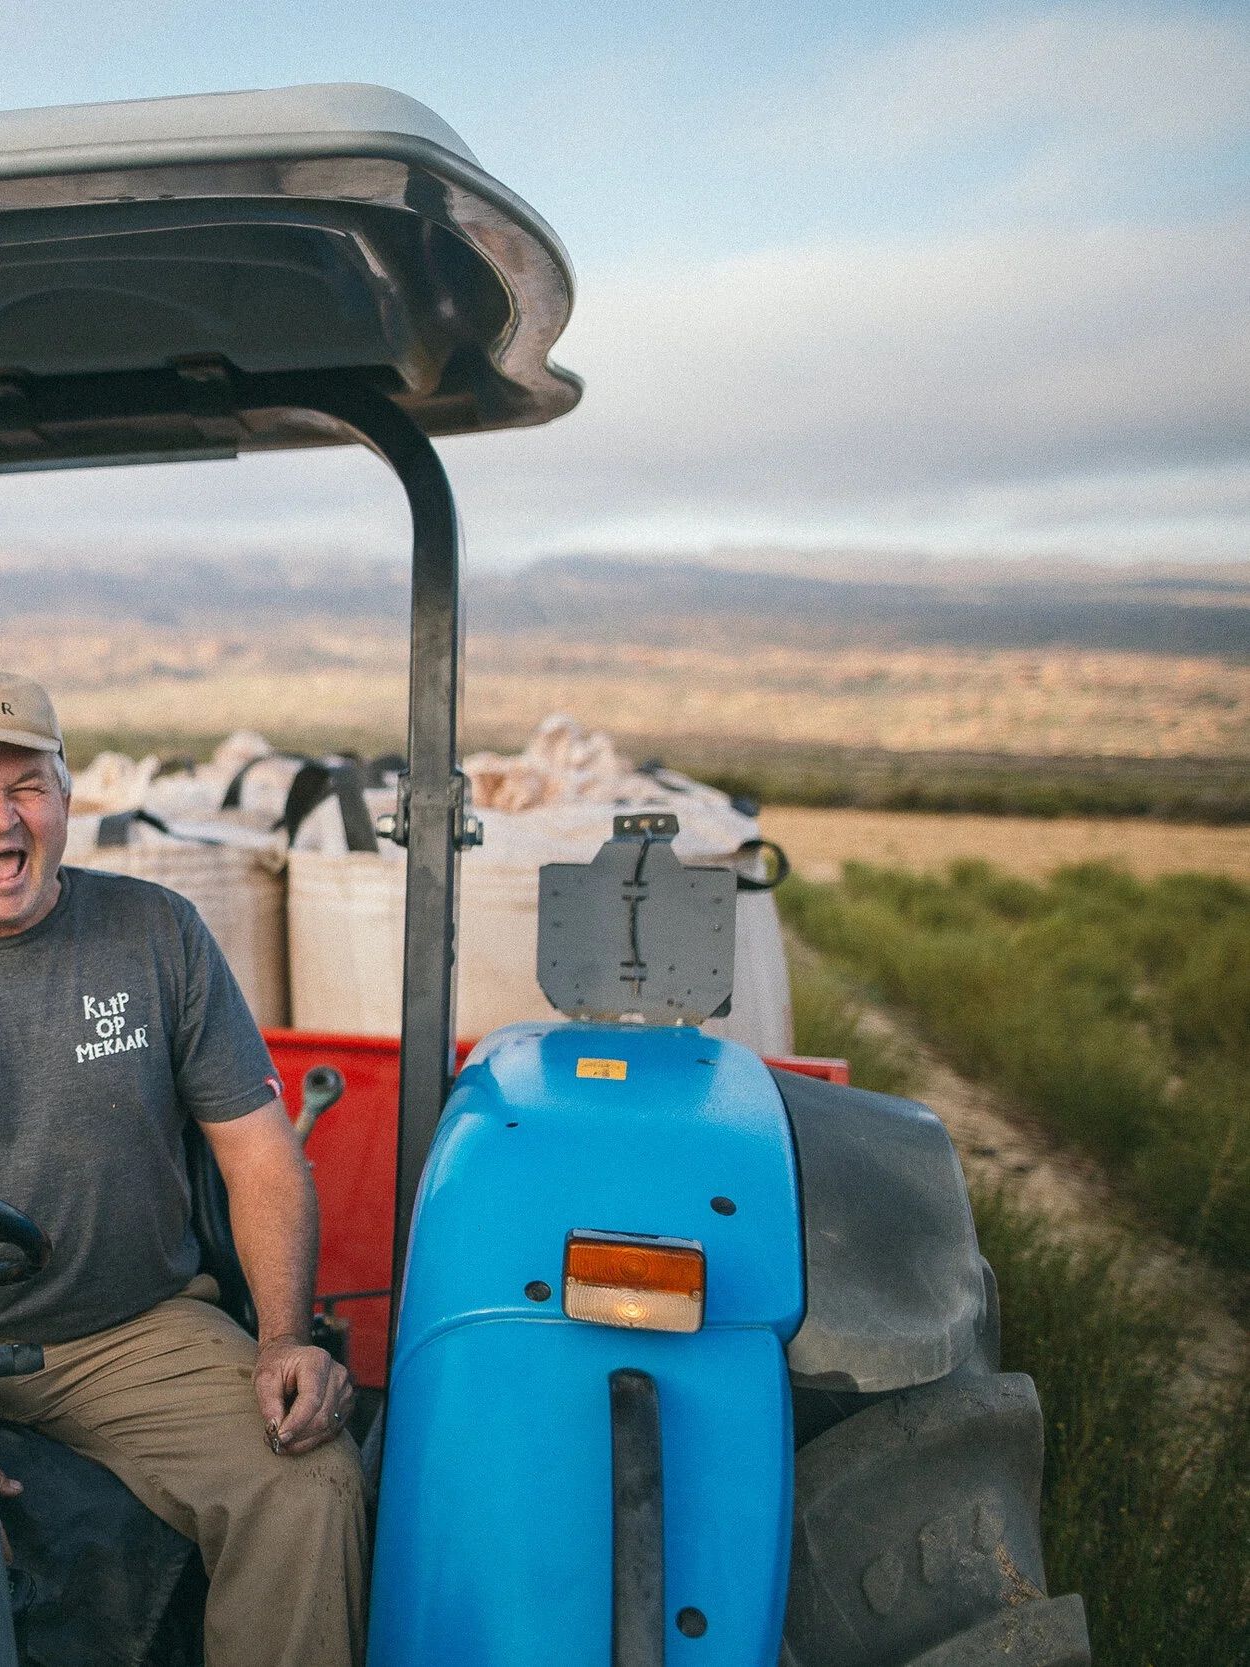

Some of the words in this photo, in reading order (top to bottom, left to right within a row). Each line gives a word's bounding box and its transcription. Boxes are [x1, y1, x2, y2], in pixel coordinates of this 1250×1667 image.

[82, 992, 130, 1020] KLIP
[95, 1016, 126, 1038] OP
[75, 1027, 149, 1063] MEKAAR
